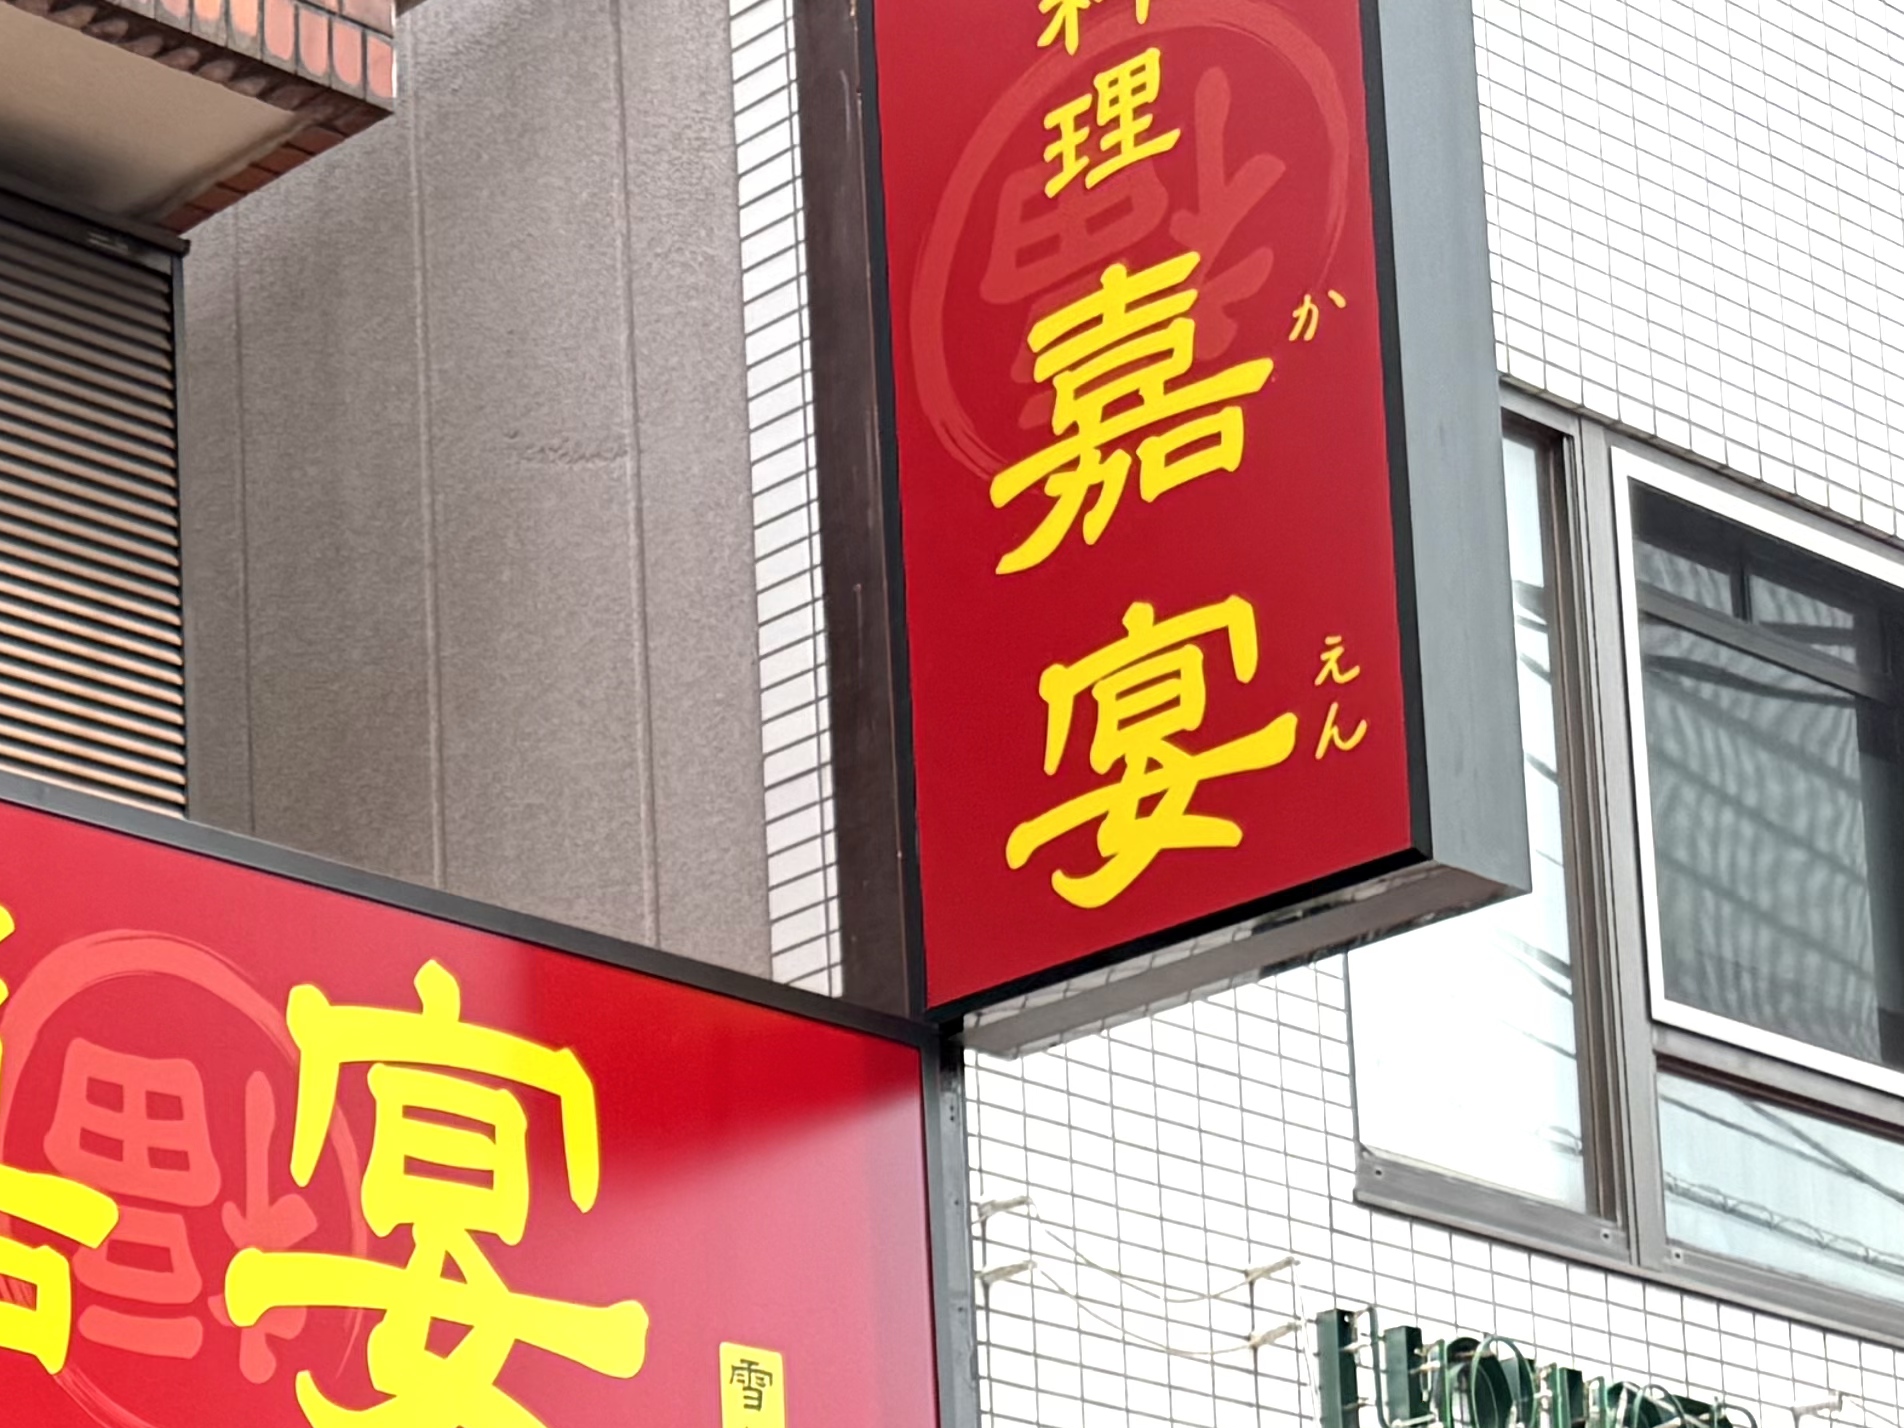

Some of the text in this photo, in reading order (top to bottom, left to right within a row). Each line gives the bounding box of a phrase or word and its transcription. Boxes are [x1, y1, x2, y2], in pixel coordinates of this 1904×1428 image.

[1290, 289, 1348, 342] か
[990, 250, 1295, 909] 嘉宴
[1314, 635, 1367, 758] えん
